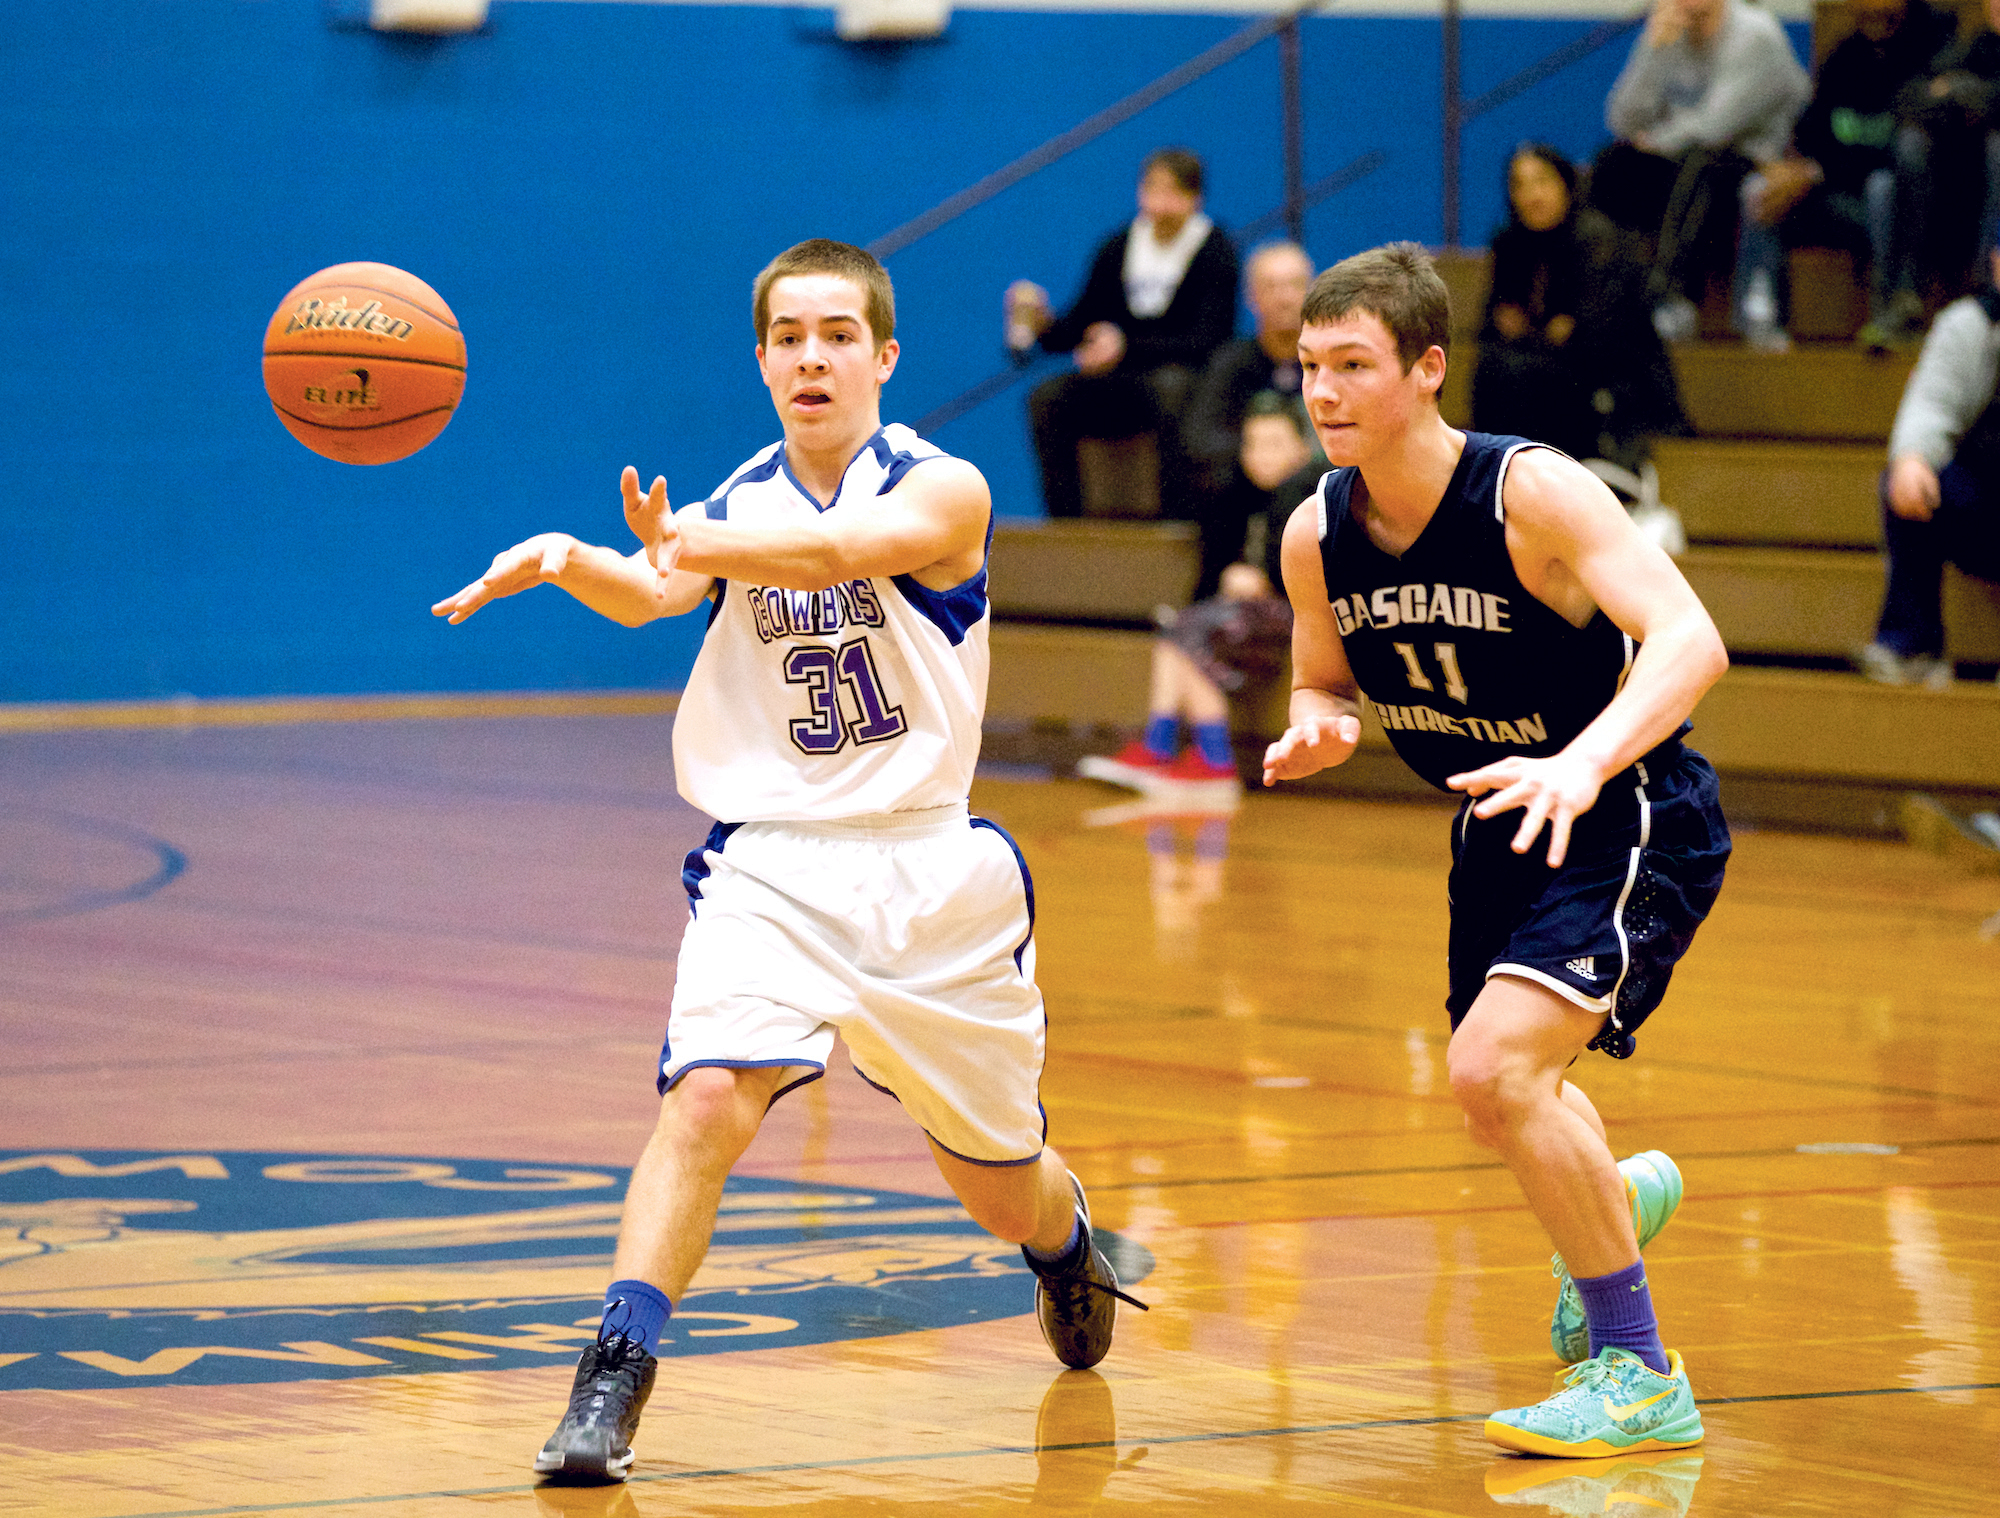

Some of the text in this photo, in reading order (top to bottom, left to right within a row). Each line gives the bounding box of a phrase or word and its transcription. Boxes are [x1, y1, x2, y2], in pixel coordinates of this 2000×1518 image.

[285, 296, 415, 342] Baden
[304, 386, 377, 406] ELITE
[748, 577, 886, 644] COWBYS
[1331, 583, 1513, 637] CASCADE
[783, 636, 908, 755] 31
[1393, 642, 1468, 705] 11
[1370, 699, 1548, 745] CHRISTIAN
